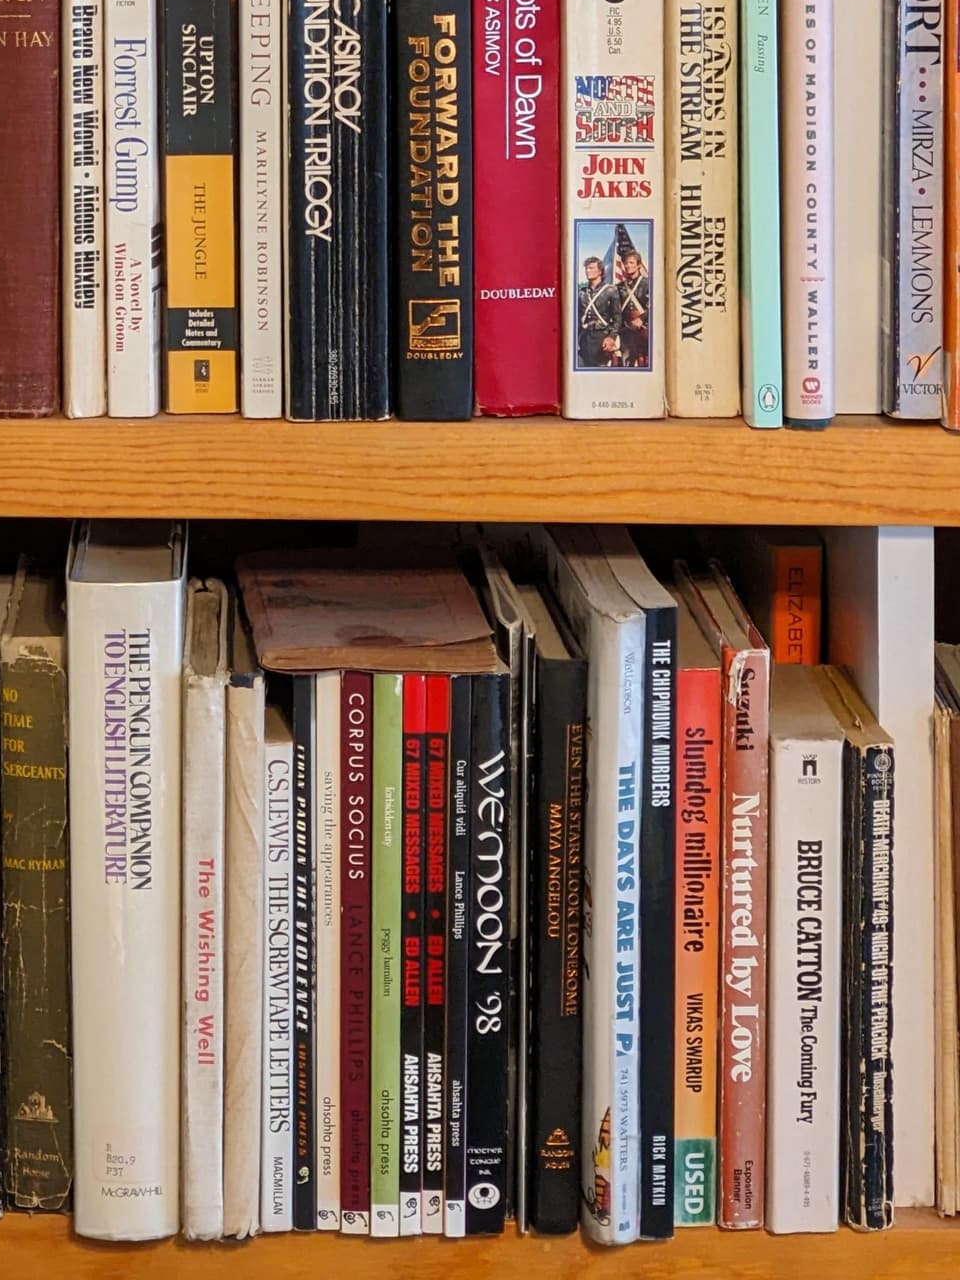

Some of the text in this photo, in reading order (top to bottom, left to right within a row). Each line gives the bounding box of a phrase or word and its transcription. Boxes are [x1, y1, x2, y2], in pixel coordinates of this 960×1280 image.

[514, 40, 542, 66] of
[514, 75, 543, 159] Dawn
[109, 37, 149, 213] Forrest Gump
[577, 178, 652, 199] JAKES
[582, 154, 645, 175] JOHN
[192, 183, 207, 281] THE JUNGLE
[255, 131, 269, 331] MARILYNNE ROBINSON
[481, 288, 556, 300] DOUBLEDAY
[104, 629, 127, 885] TO ENGLISH LITERATURE
[128, 628, 152, 890] THE PENGUIN COMPANION
[348, 693, 365, 879] CORPUS SOCIUS
[651, 640, 671, 808] THE CHIPMUNK MURDERS
[194, 858, 216, 1065] The Wishing Well
[796, 840, 823, 1124] BRUCE CATTON The Coming Fury
[686, 993, 703, 1093] VIKAS SWARUP
[684, 1152, 704, 1214] USED
